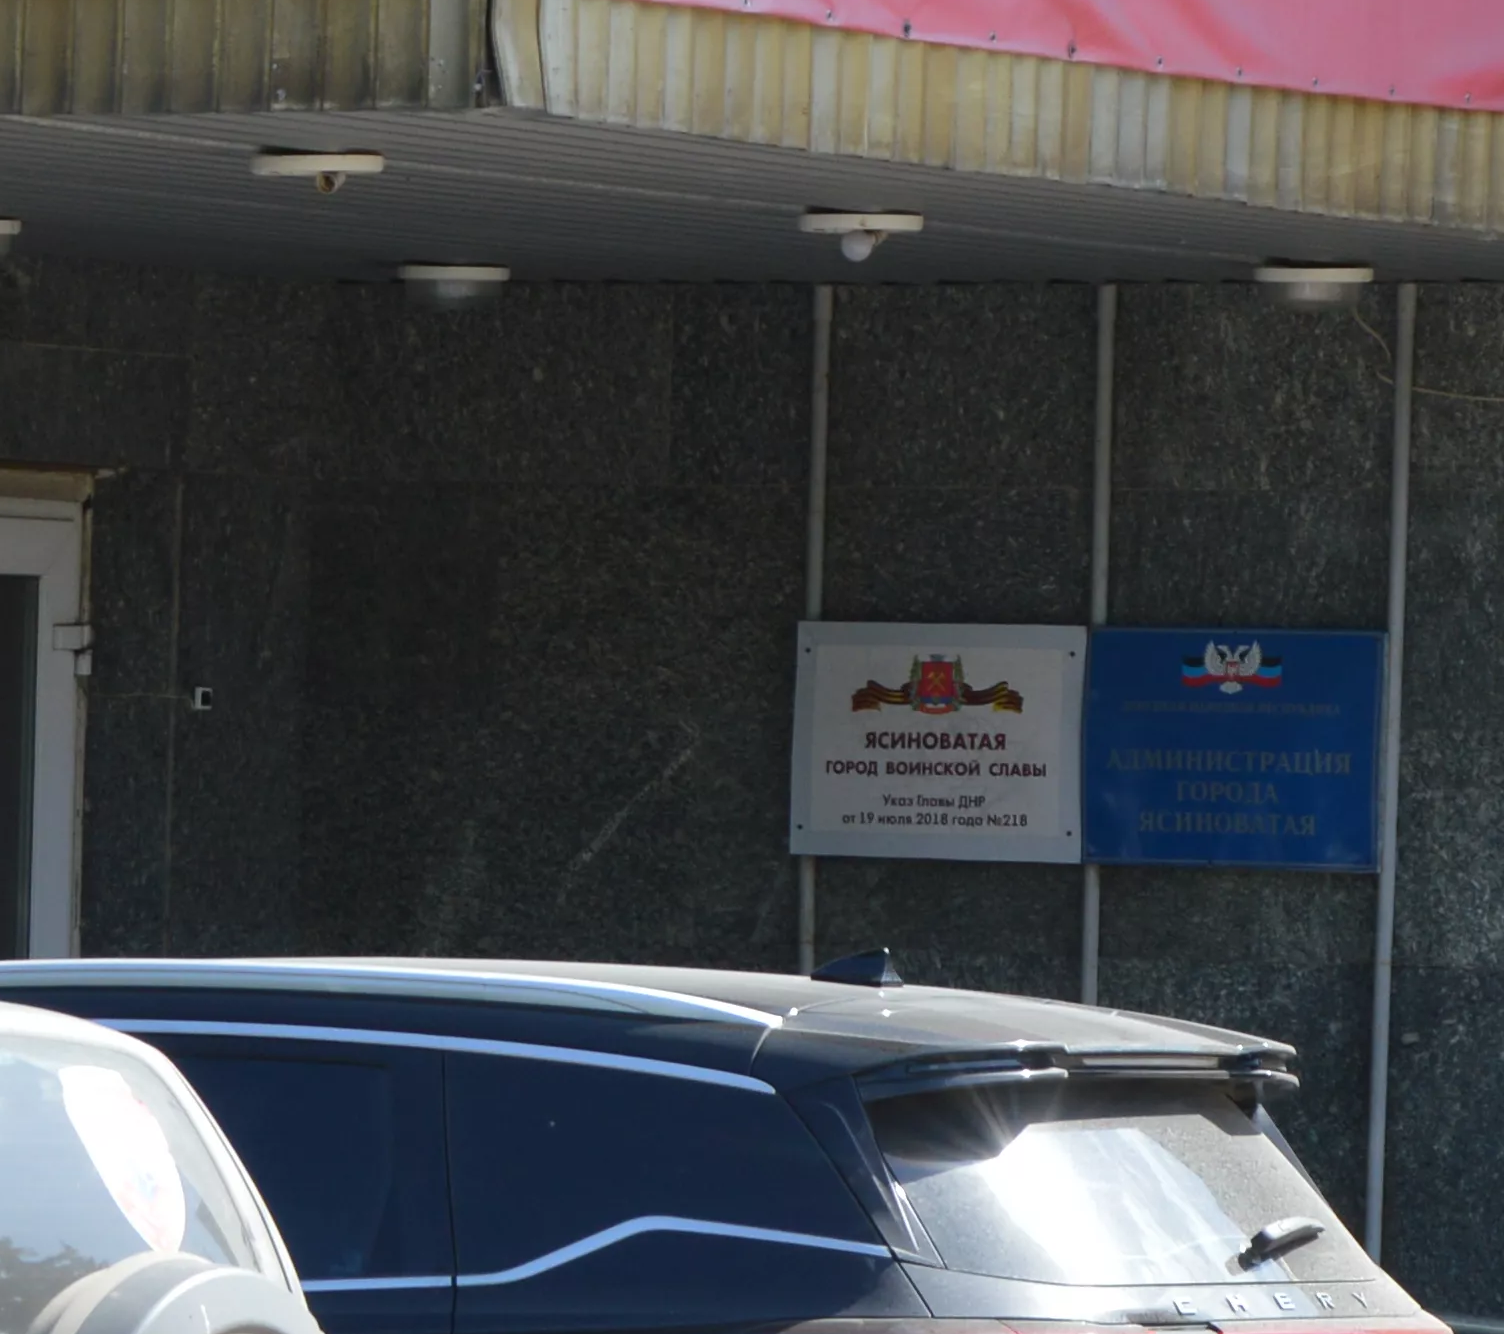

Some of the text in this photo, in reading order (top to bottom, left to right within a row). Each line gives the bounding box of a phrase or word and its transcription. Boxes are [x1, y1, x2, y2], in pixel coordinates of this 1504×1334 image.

[865, 732, 1006, 750] ЯСИНОВАТАЯ
[826, 758, 1047, 777] ГОРОД ВОИНСКОЙ СЛАВЫ
[1107, 749, 1352, 775] АДМИНИСТРАЦИЯ
[883, 793, 986, 809] Указ Главы ДНР
[1176, 781, 1279, 804] ГОРОДА
[842, 812, 1028, 828] от 19 июля 2018 года №218
[1139, 810, 1317, 836] ЯСИНОВАТАЯ
[1172, 1291, 1370, 1315] CHERY
